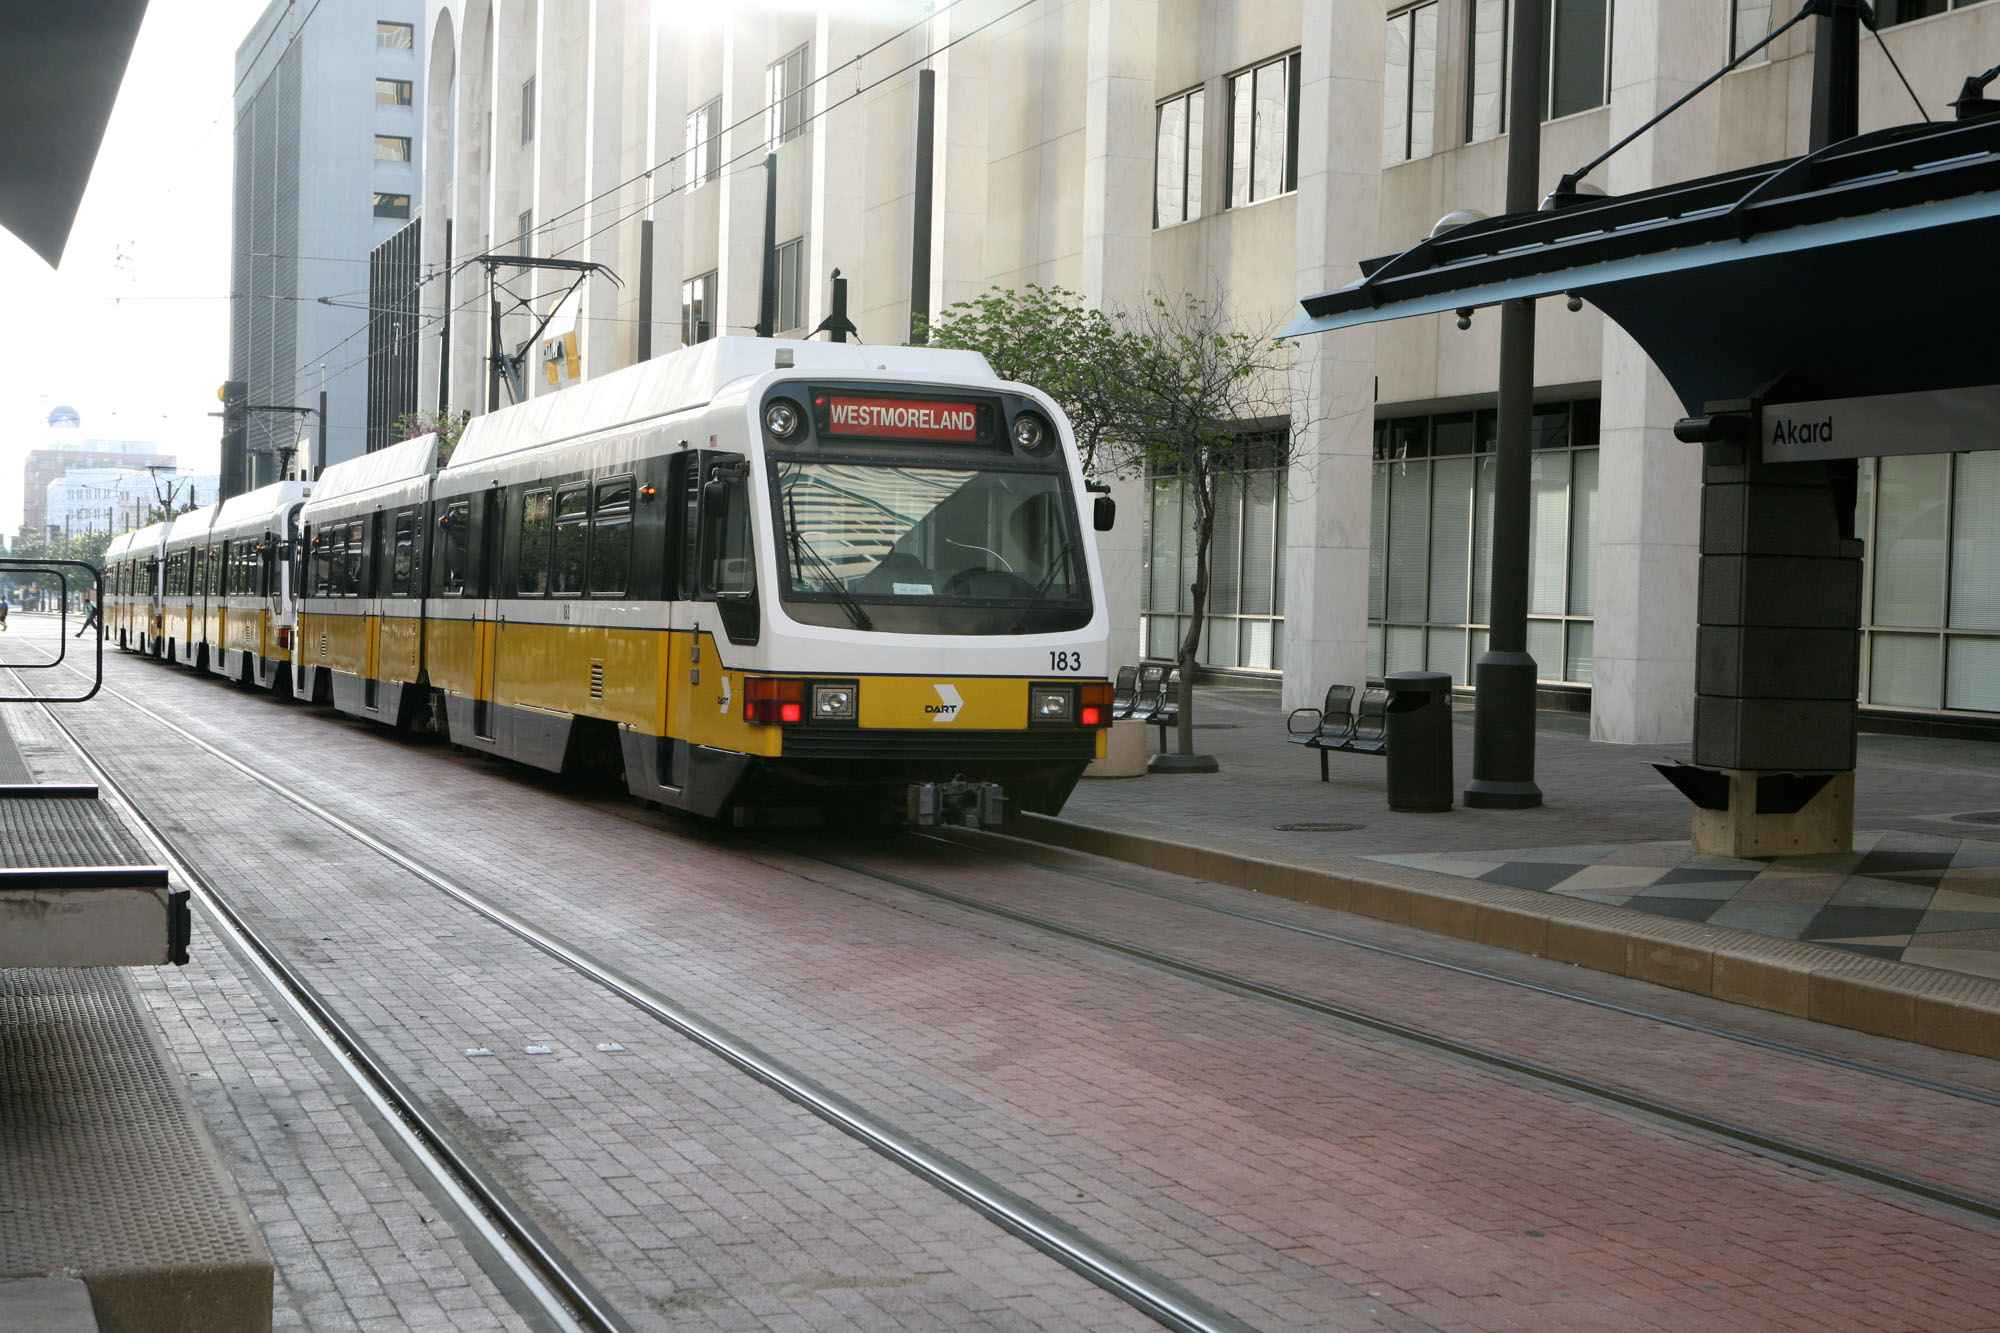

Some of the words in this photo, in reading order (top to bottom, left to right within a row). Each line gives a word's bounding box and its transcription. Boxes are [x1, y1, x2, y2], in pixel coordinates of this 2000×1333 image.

[831, 404, 975, 431] WESTMORELAND
[1772, 416, 1832, 446] Akard
[1050, 651, 1082, 671] 183
[925, 705, 957, 714] DART
